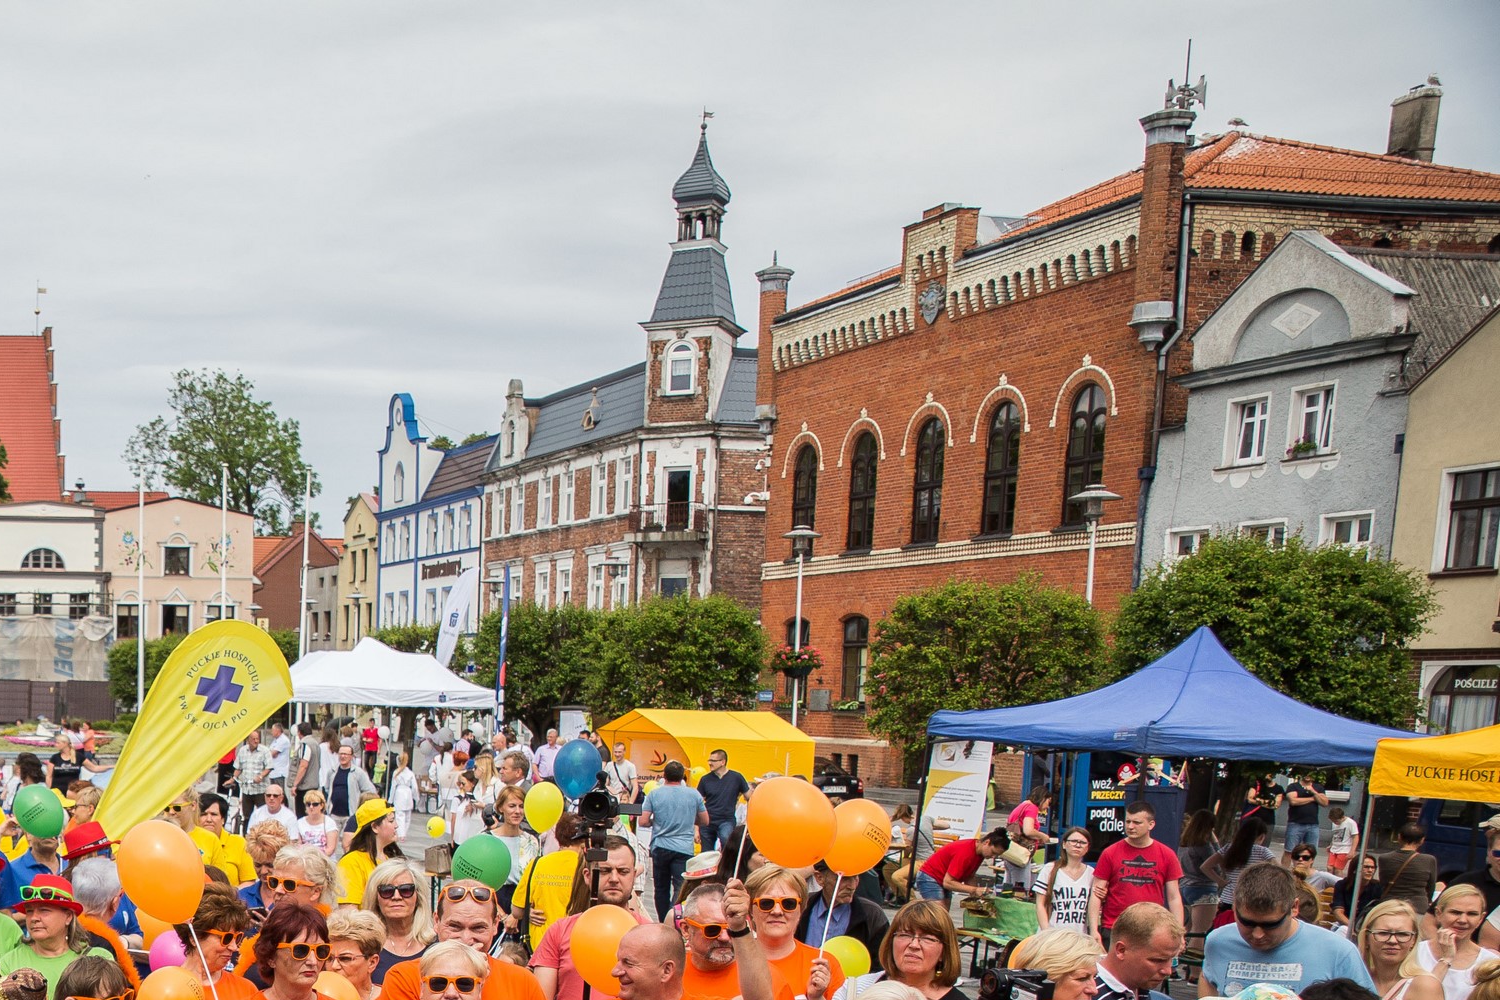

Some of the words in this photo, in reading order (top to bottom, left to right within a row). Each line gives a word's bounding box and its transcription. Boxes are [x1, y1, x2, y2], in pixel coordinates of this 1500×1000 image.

[223, 649, 260, 692] HOSPICJUM
[1454, 678, 1498, 689] POŚCIELE
[202, 721, 228, 731] OJCA
[230, 708, 248, 724] PIO
[1405, 765, 1456, 780] PUCKIE
[1090, 808, 1115, 820] podaj
